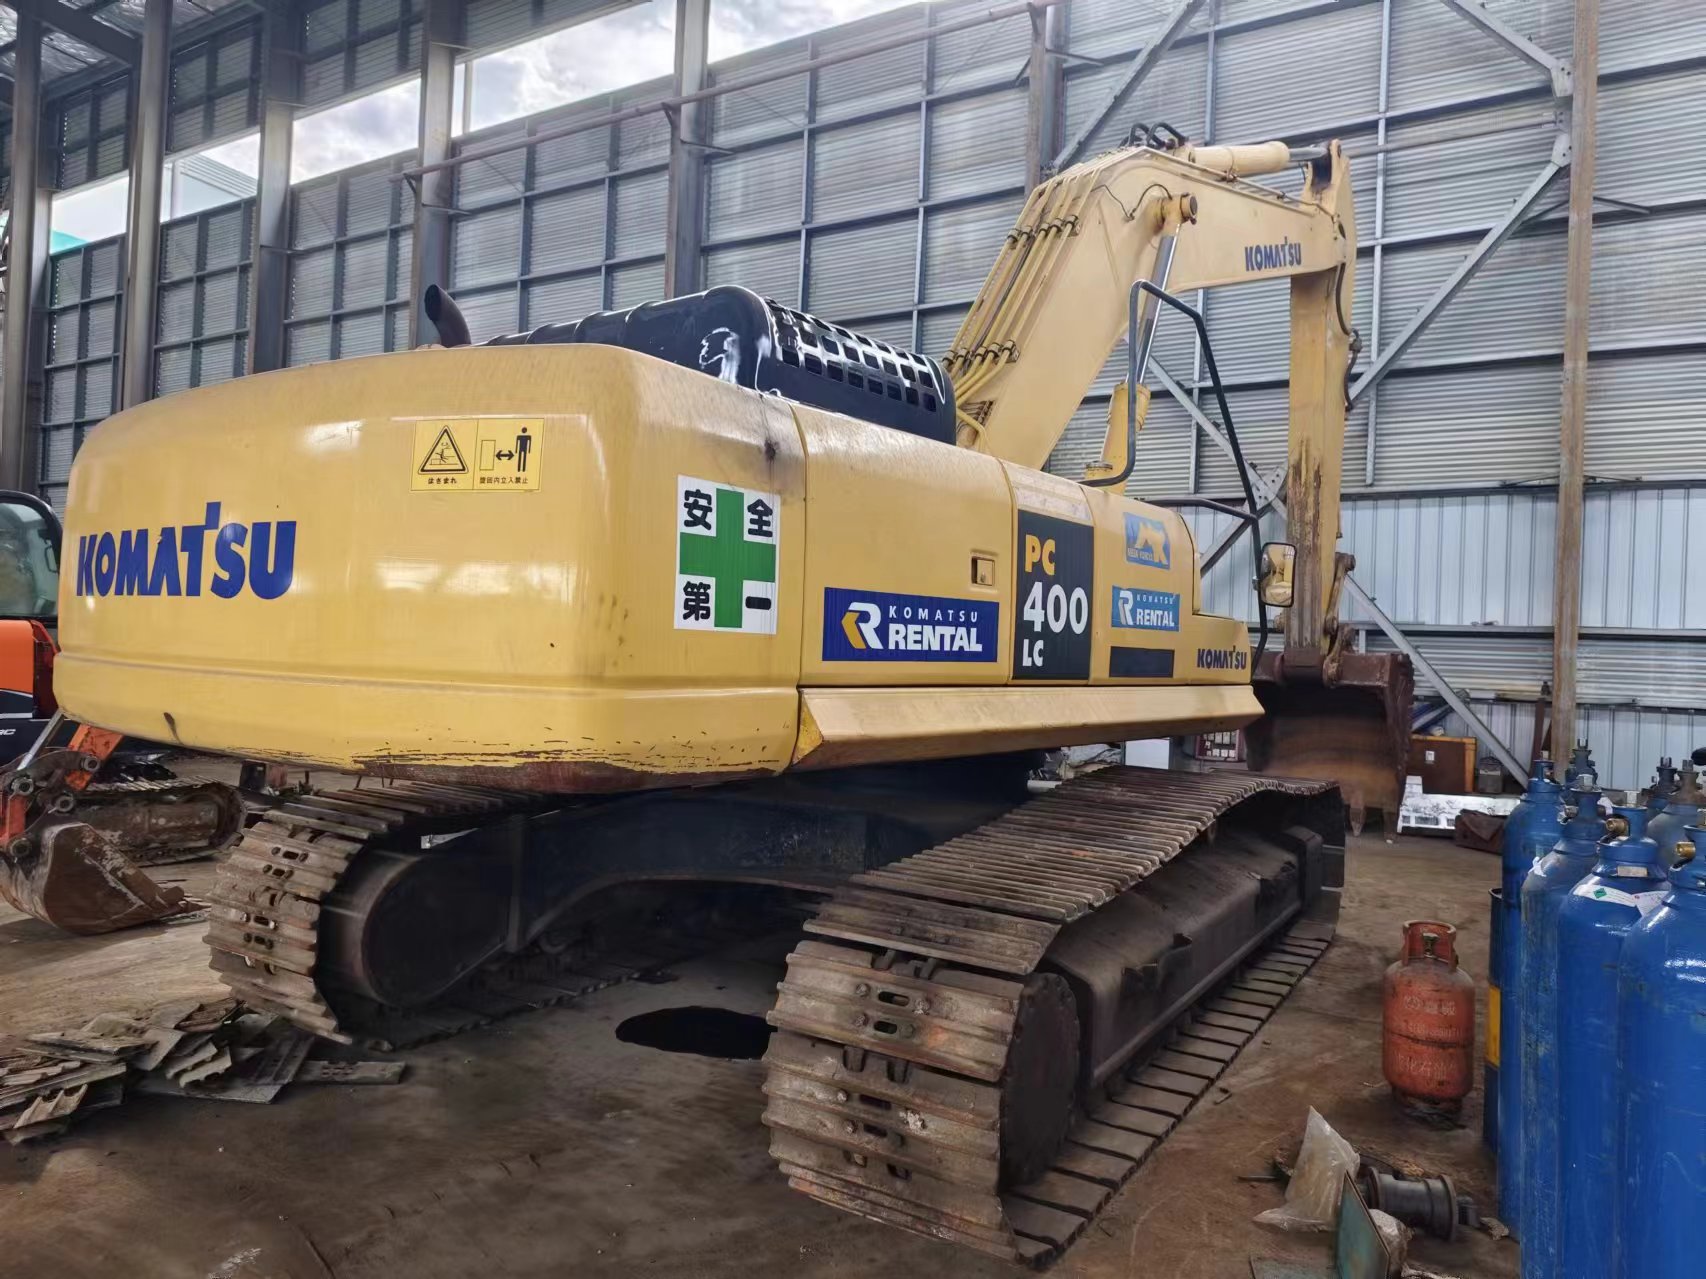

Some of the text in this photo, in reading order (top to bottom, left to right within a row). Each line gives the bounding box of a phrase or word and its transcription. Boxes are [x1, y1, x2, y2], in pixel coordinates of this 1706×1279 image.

[1245, 236, 1301, 272] KOMATSU
[76, 501, 296, 600] KOMATSU
[1024, 534, 1056, 576] PC
[1023, 581, 1089, 635] 400
[1136, 592, 1174, 605] KOMATSU
[889, 605, 978, 623] KOMATSU
[1136, 608, 1175, 628] RENTAL
[888, 623, 983, 652] RENTAL
[1022, 638, 1044, 667] LC
[1197, 645, 1247, 670] KOMATSU
